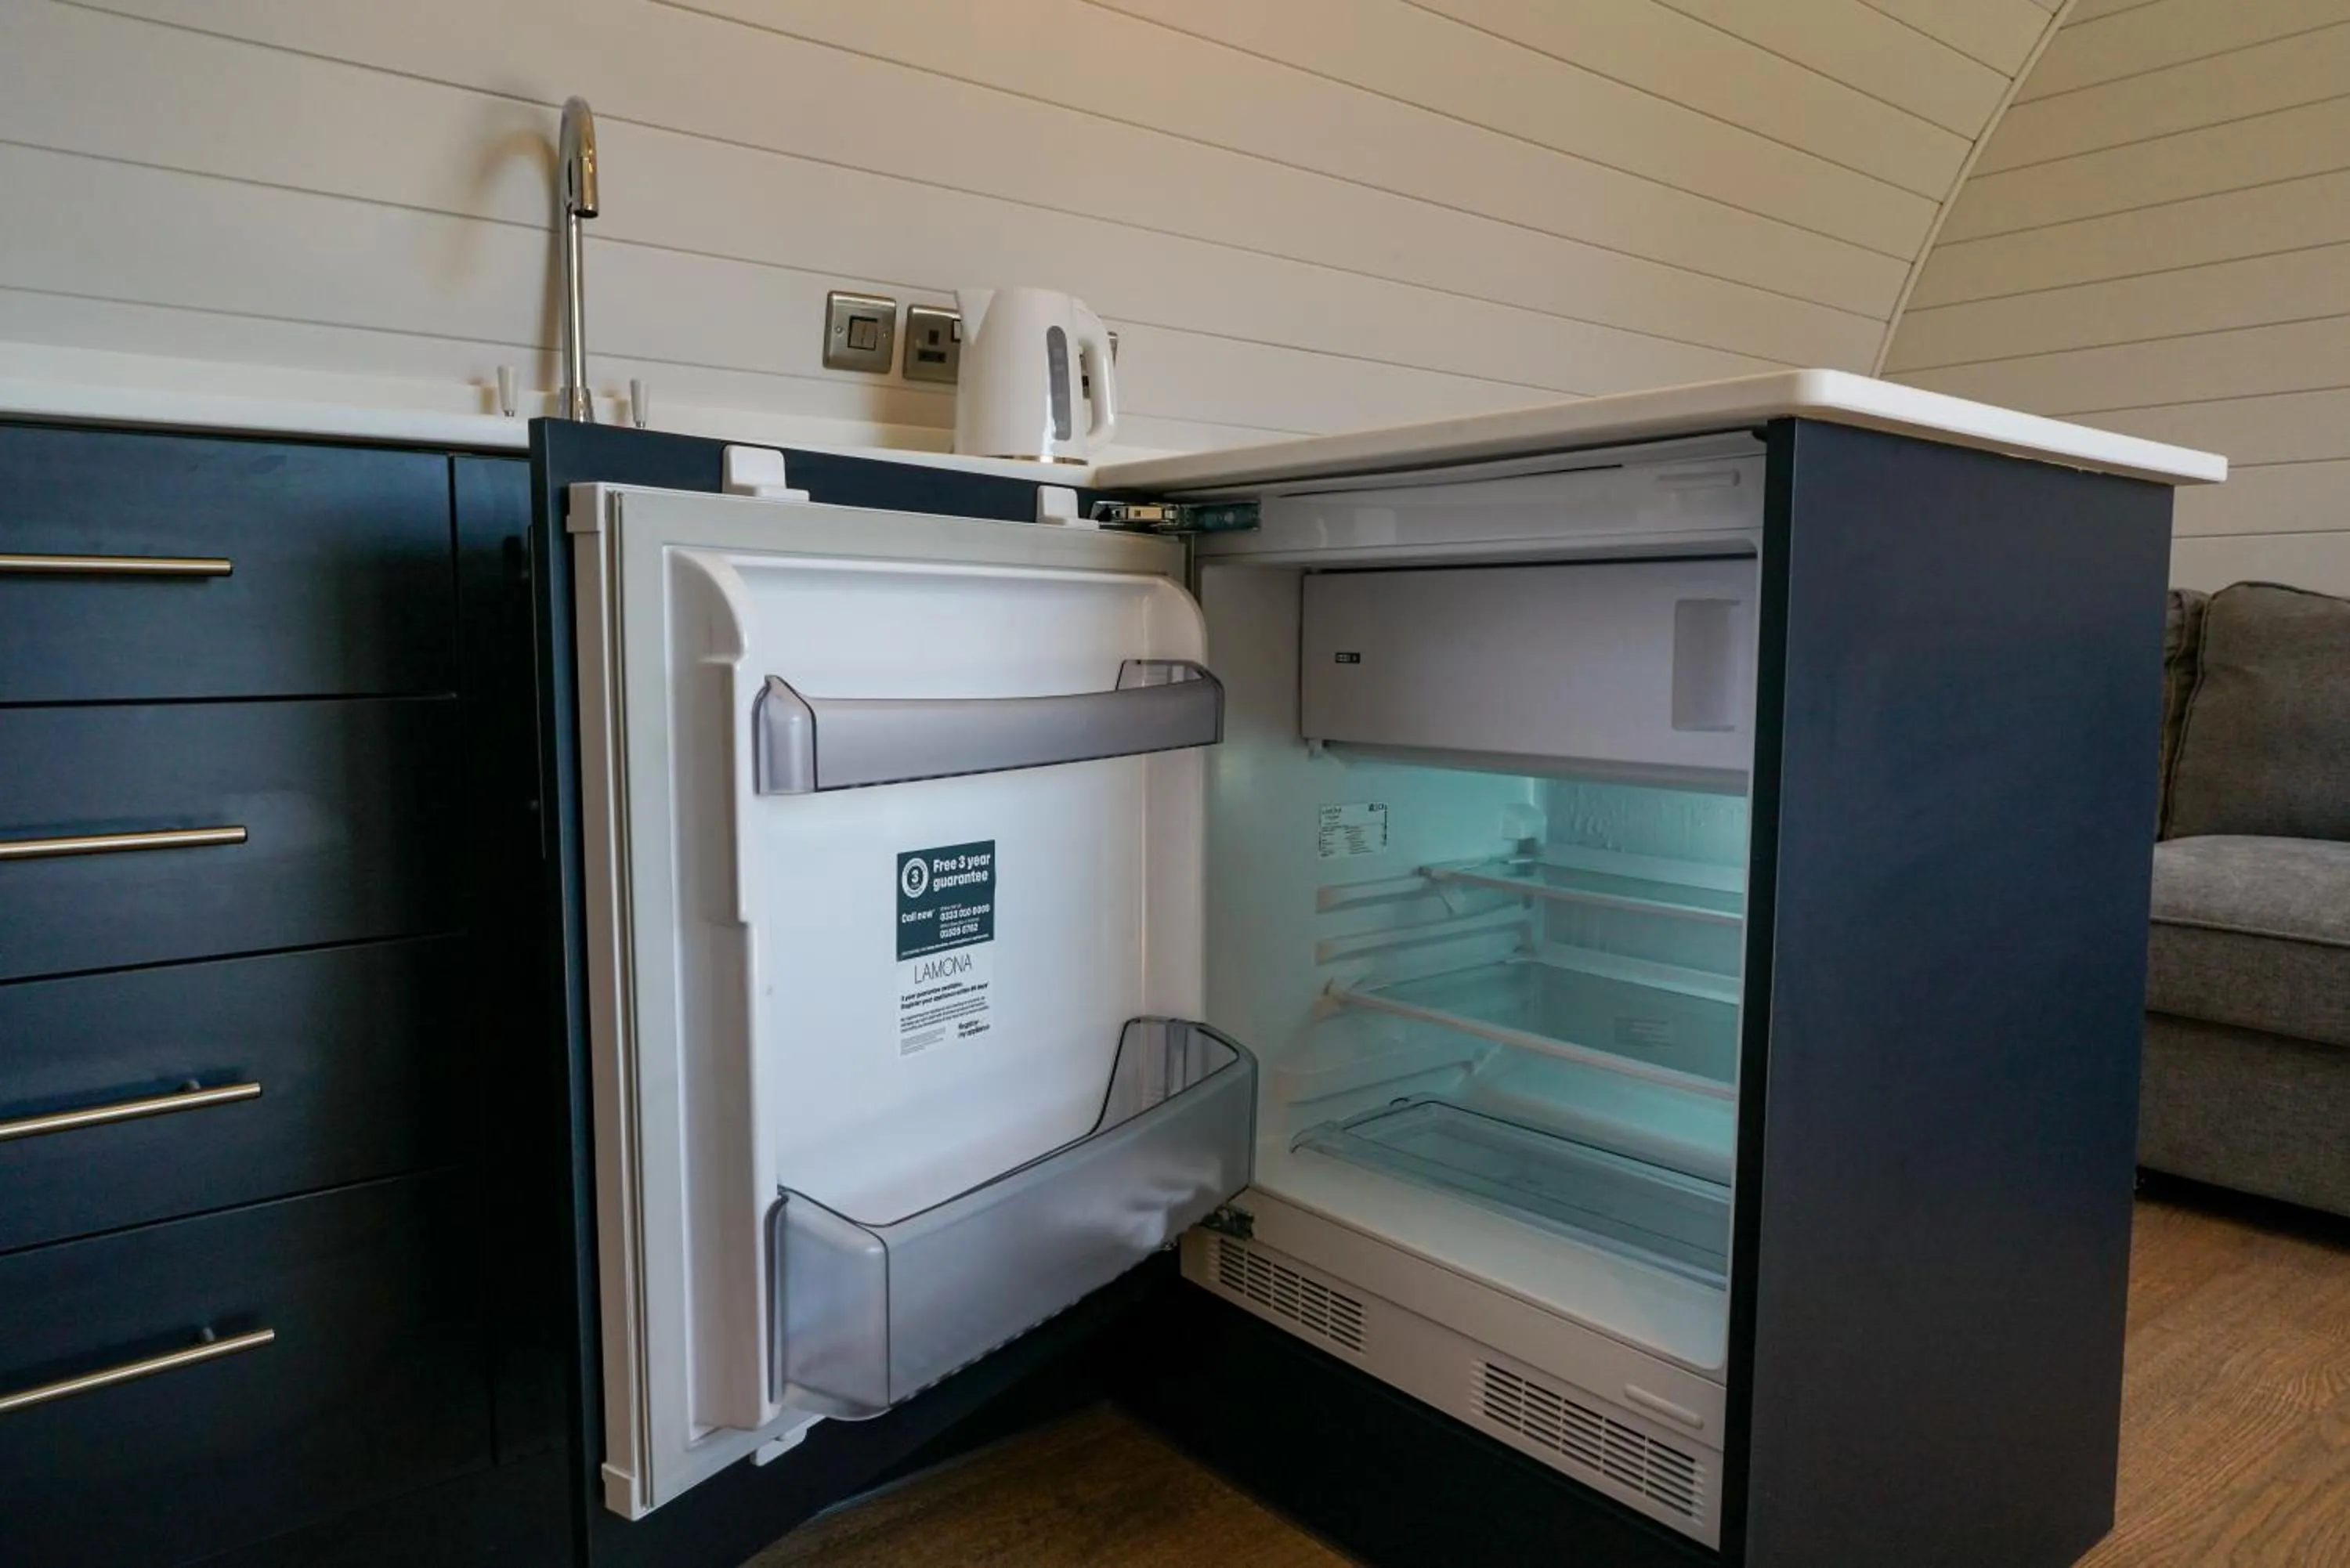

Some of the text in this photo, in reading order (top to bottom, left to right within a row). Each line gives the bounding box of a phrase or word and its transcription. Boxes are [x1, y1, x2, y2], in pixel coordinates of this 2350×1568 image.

[933, 854, 991, 873] Free 3 year
[911, 869, 920, 883] 3
[933, 870, 989, 892] guarantee
[902, 911, 917, 923] Call
[914, 953, 972, 985] LAMONA
